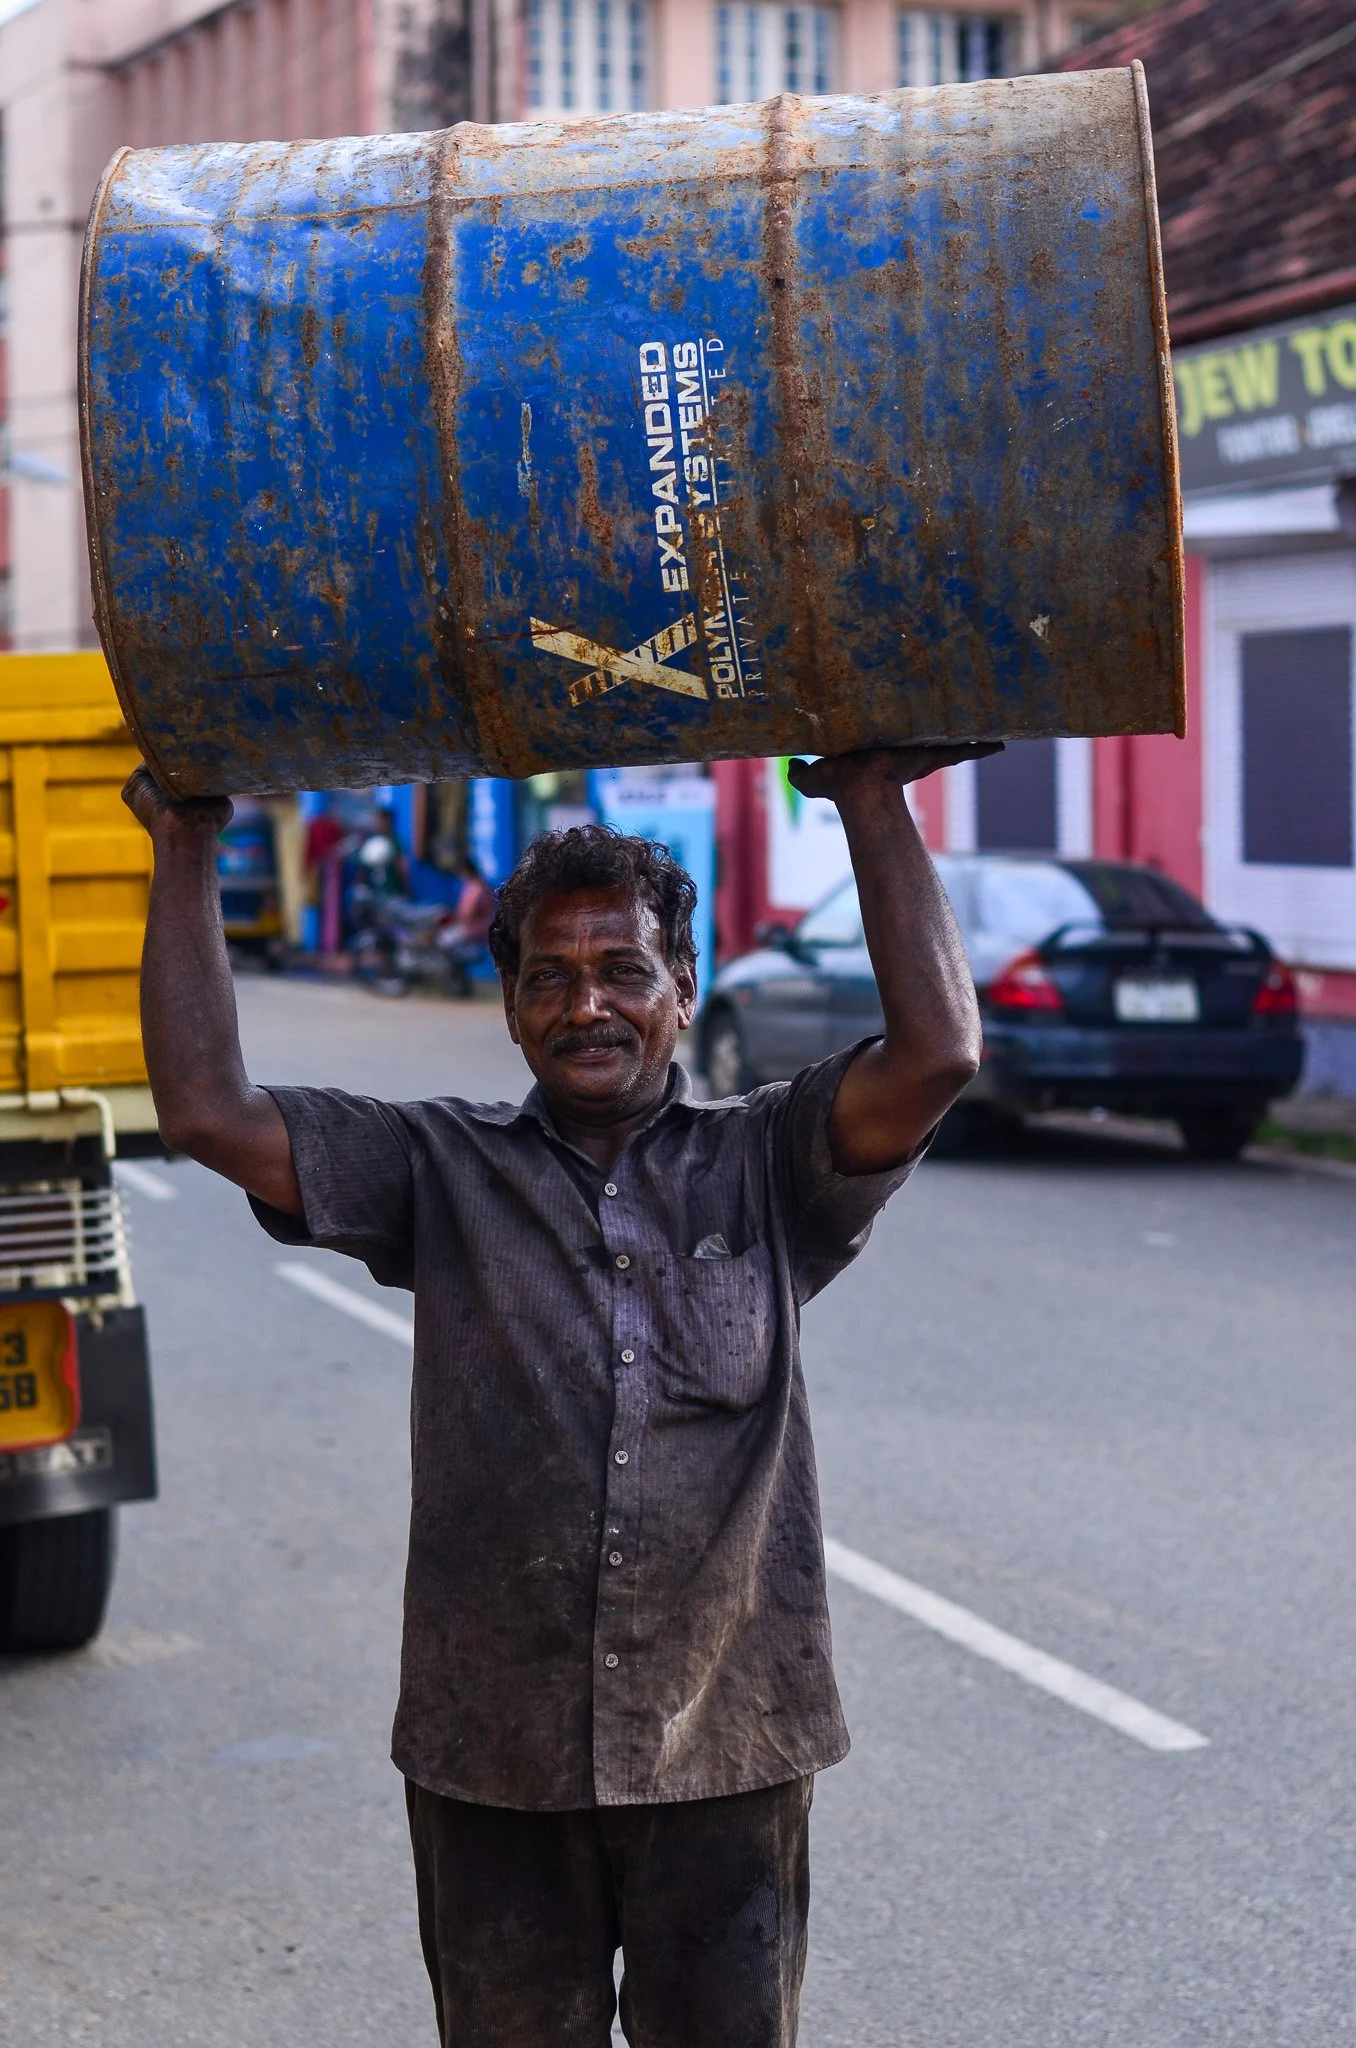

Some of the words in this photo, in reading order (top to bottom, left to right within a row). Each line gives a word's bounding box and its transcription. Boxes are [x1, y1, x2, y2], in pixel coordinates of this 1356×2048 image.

[639, 341, 690, 592] EXPANDED
[673, 341, 715, 538] SYSTEMS
[706, 338, 740, 511] IMITED
[1175, 339, 1279, 437] JEW
[697, 550, 739, 699] POLYMR
[728, 571, 767, 698] PRIVATE
